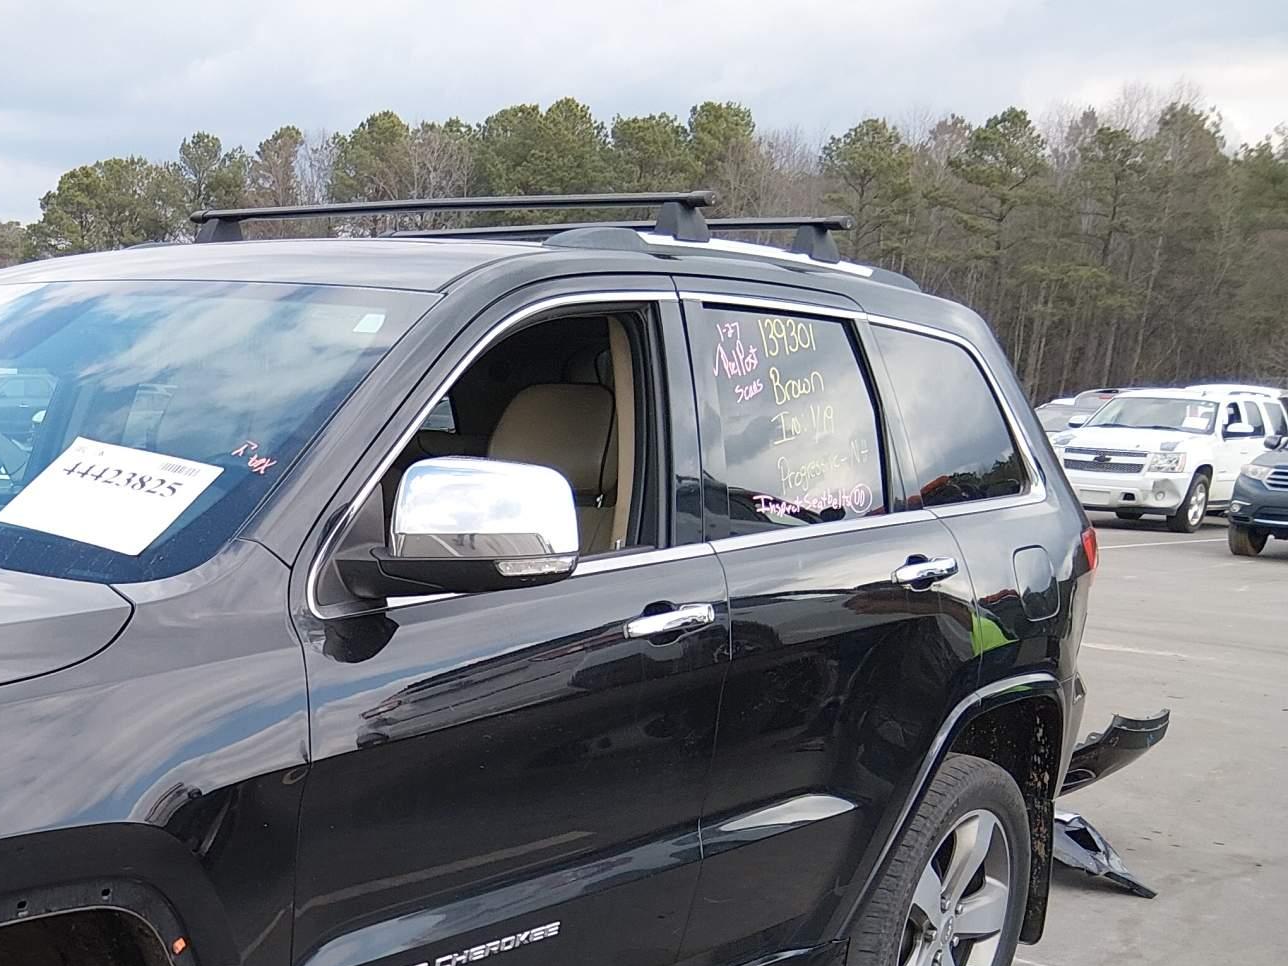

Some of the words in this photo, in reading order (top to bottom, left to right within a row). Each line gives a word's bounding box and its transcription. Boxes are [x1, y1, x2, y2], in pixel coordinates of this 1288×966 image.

[716, 321, 741, 342] 1-27
[758, 318, 816, 358] 139301
[769, 366, 825, 406] Brown
[62, 461, 184, 498] 44423825
